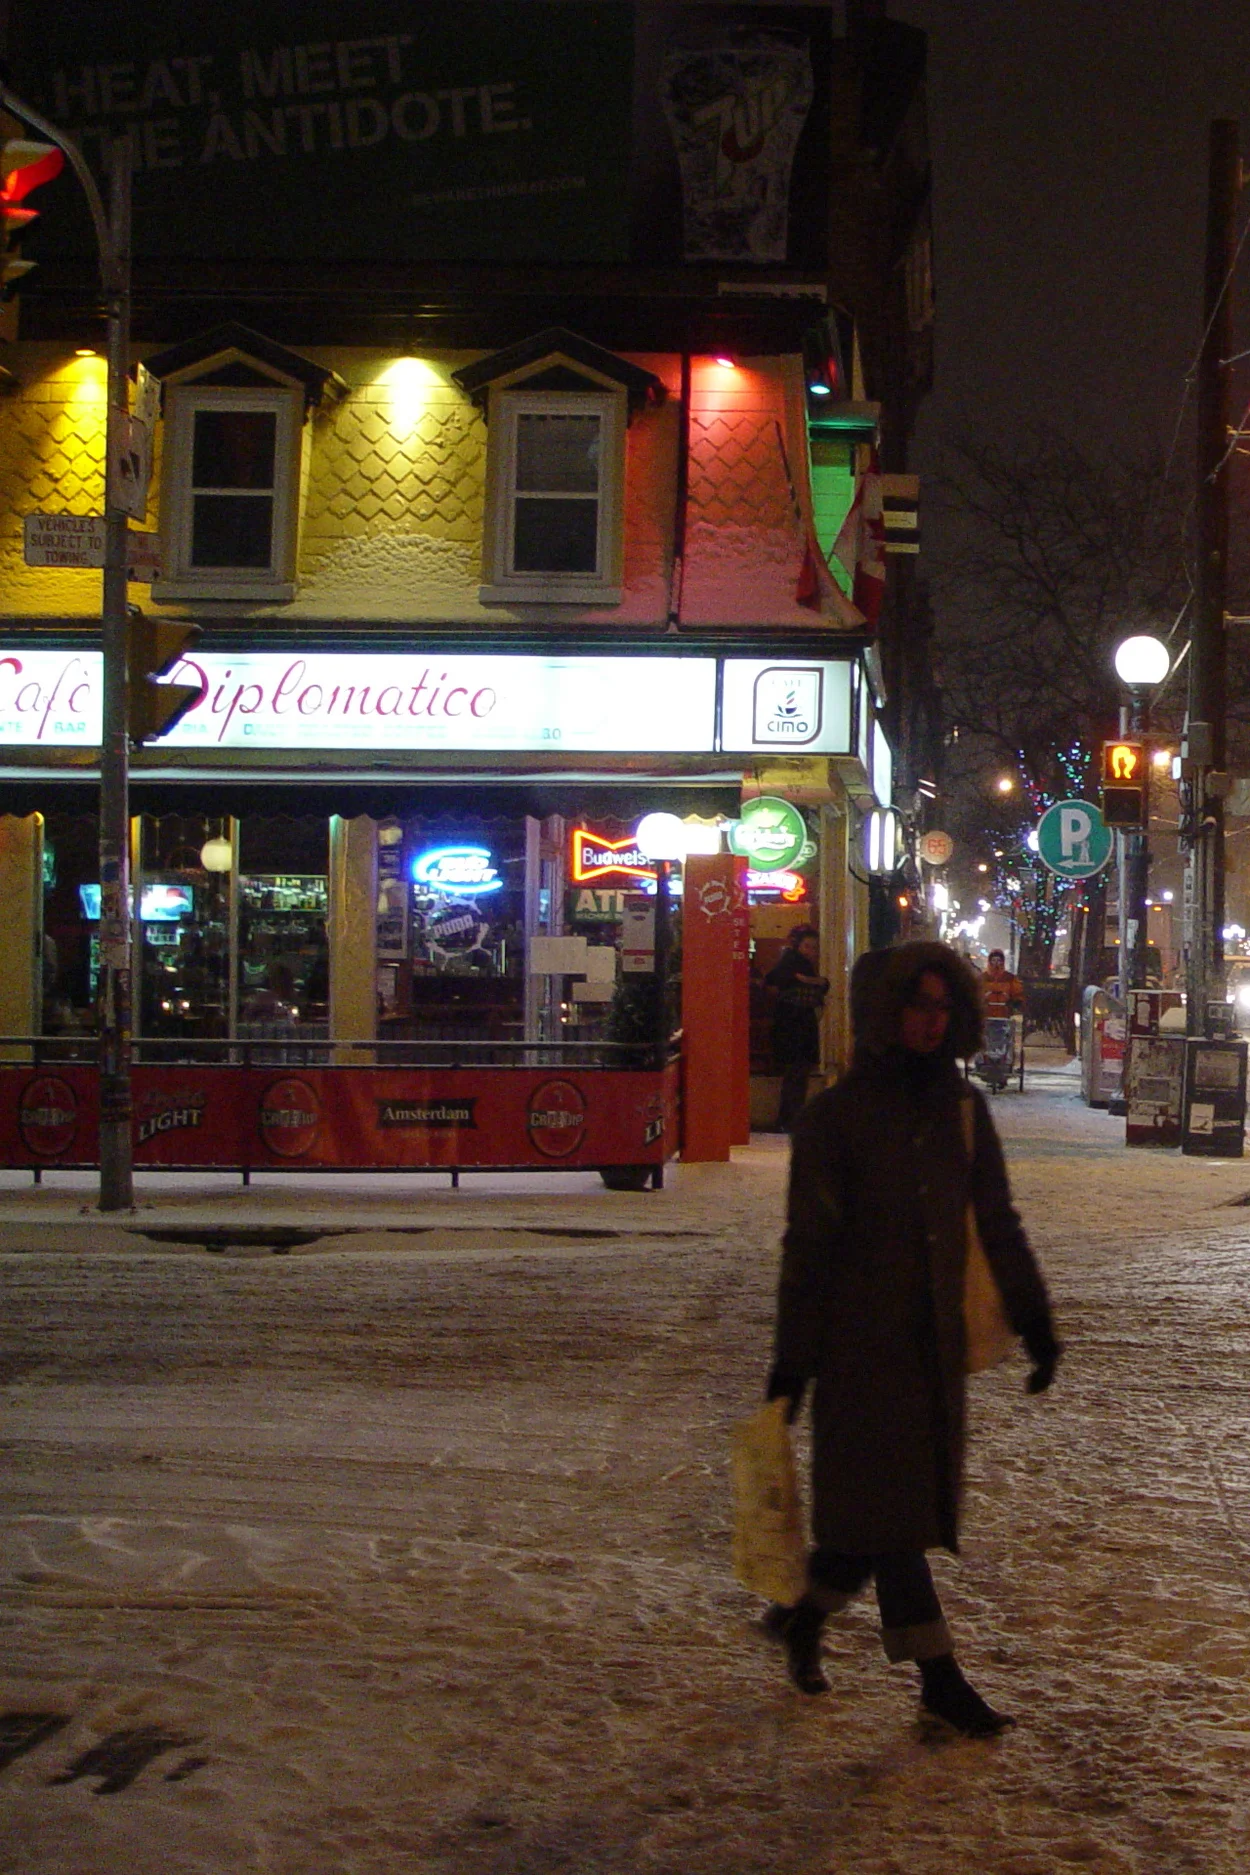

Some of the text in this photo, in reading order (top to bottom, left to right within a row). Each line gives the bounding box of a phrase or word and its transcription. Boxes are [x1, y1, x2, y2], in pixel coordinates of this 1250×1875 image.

[53, 34, 412, 118] HEAT, MEET
[202, 84, 534, 163] ANTIDOTE.
[30, 533, 103, 550] SUBJECT TO
[37, 518, 95, 532] VEHICLES
[45, 550, 89, 565] TOWING
[168, 657, 498, 743] Diplomatico
[1061, 808, 1092, 857] P
[138, 1107, 203, 1142] LIGHT
[382, 1105, 471, 1121] Amsterdam
